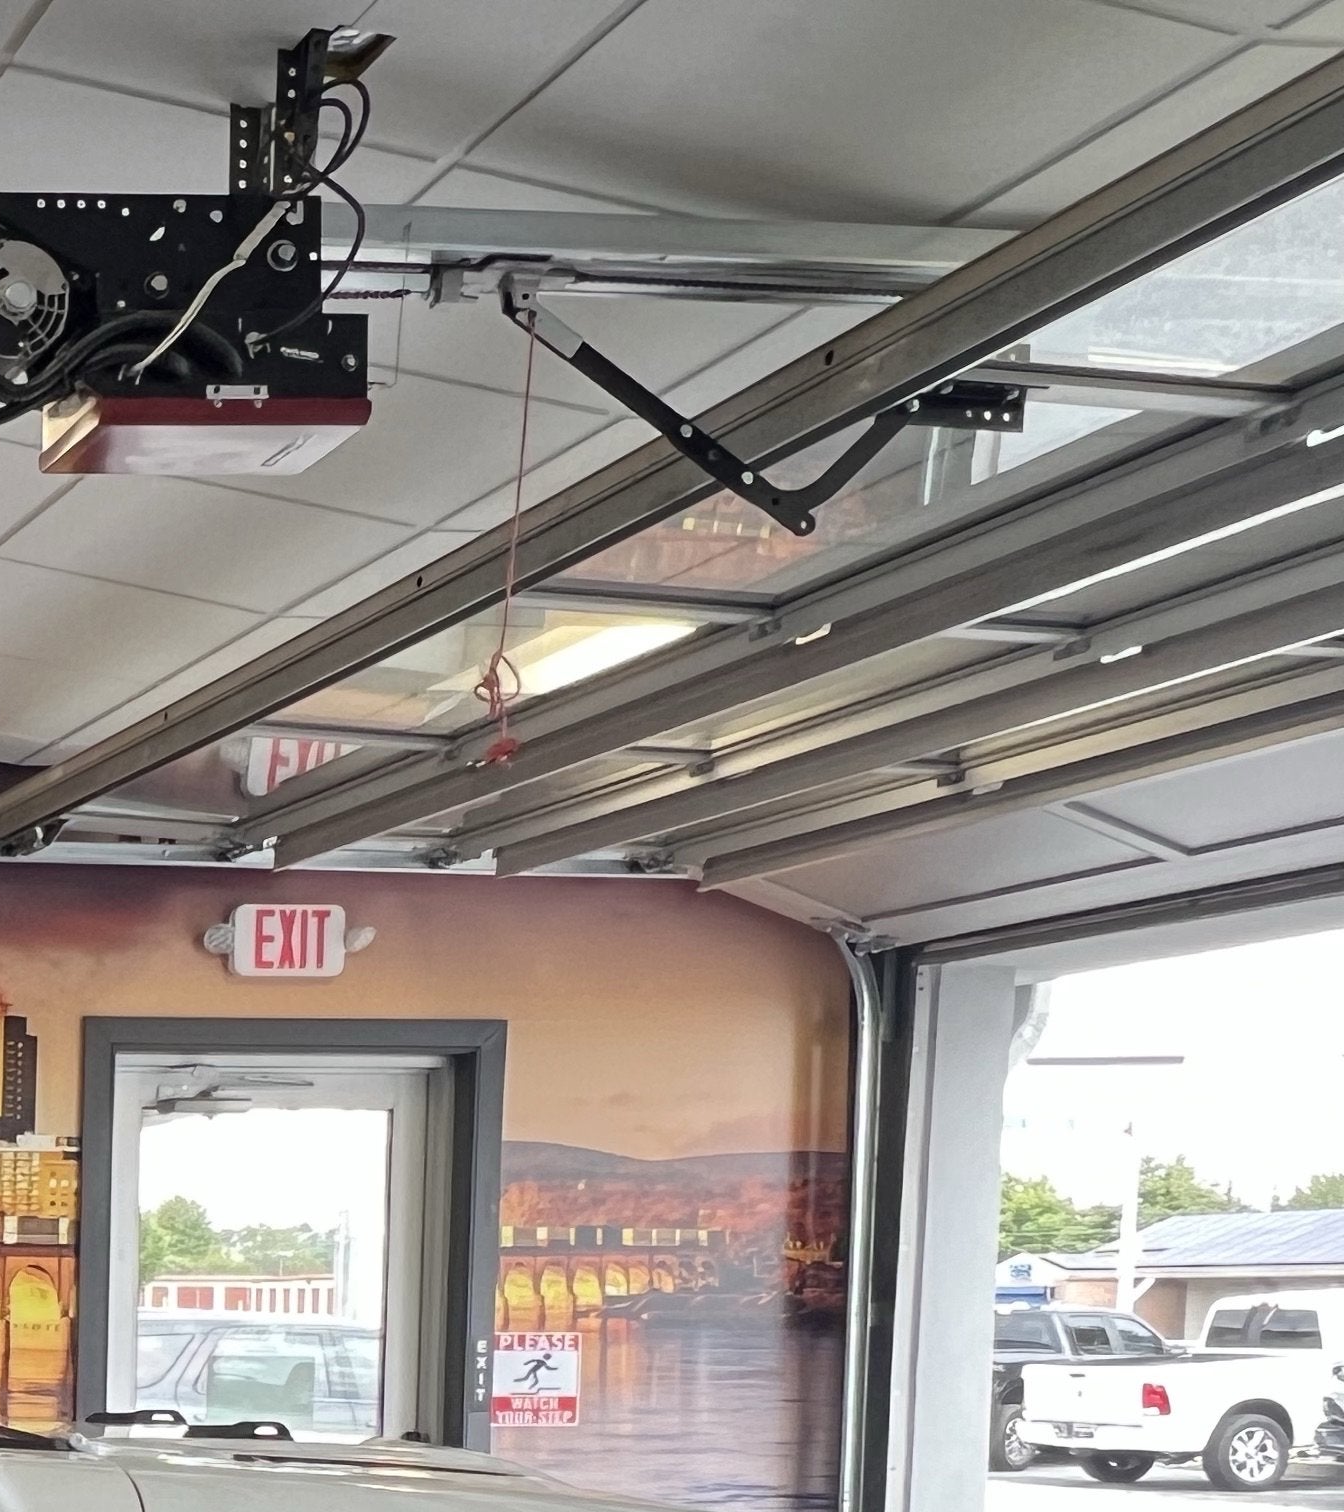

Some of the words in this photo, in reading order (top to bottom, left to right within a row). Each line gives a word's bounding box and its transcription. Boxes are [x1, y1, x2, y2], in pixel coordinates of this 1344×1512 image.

[255, 909, 331, 969] EXIT
[499, 1334, 576, 1351] PLEASE
[475, 1340, 488, 1402] EXIT
[511, 1397, 559, 1411] WATCH
[495, 1410, 534, 1425] YOUR
[537, 1410, 573, 1425] STEP
